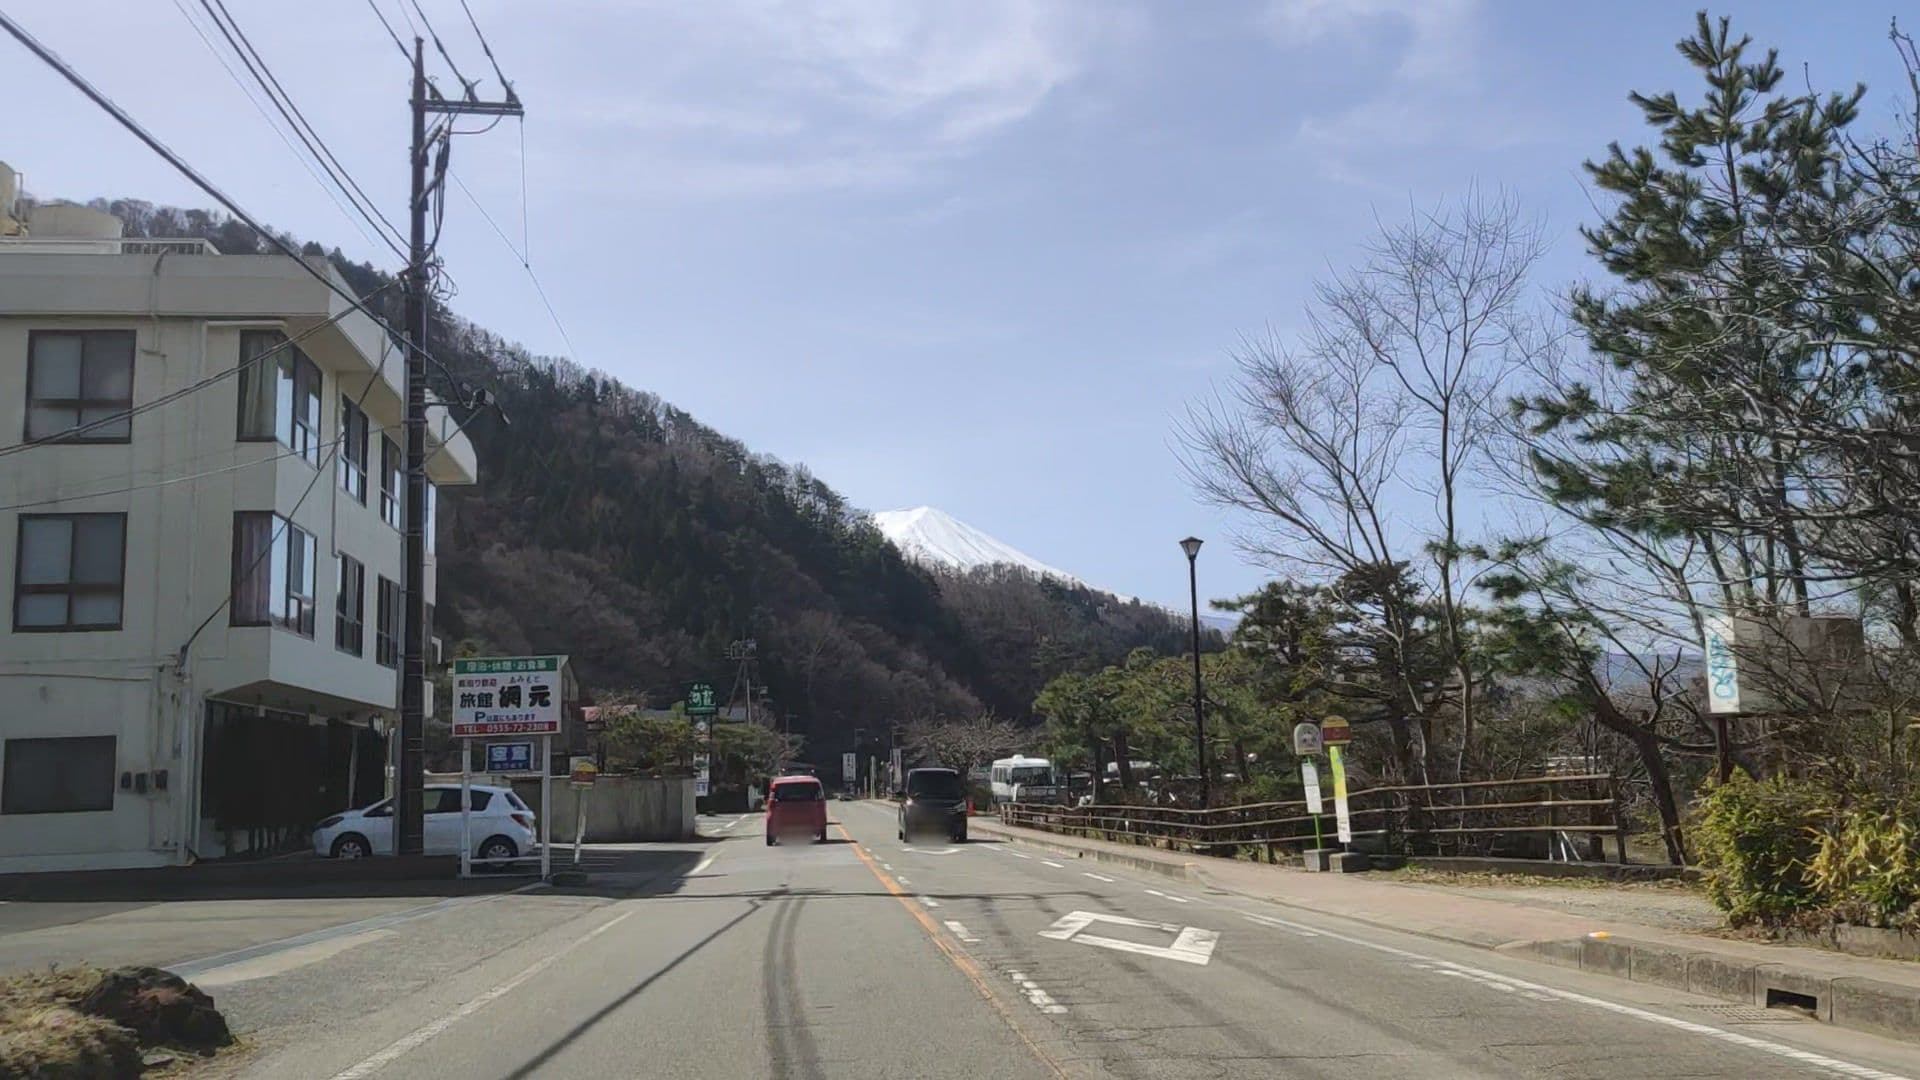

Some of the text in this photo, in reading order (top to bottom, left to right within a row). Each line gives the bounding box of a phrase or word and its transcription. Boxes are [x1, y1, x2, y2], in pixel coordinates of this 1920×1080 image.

[460, 685, 551, 708] 旅館 網元
[464, 725, 480, 733] TEL
